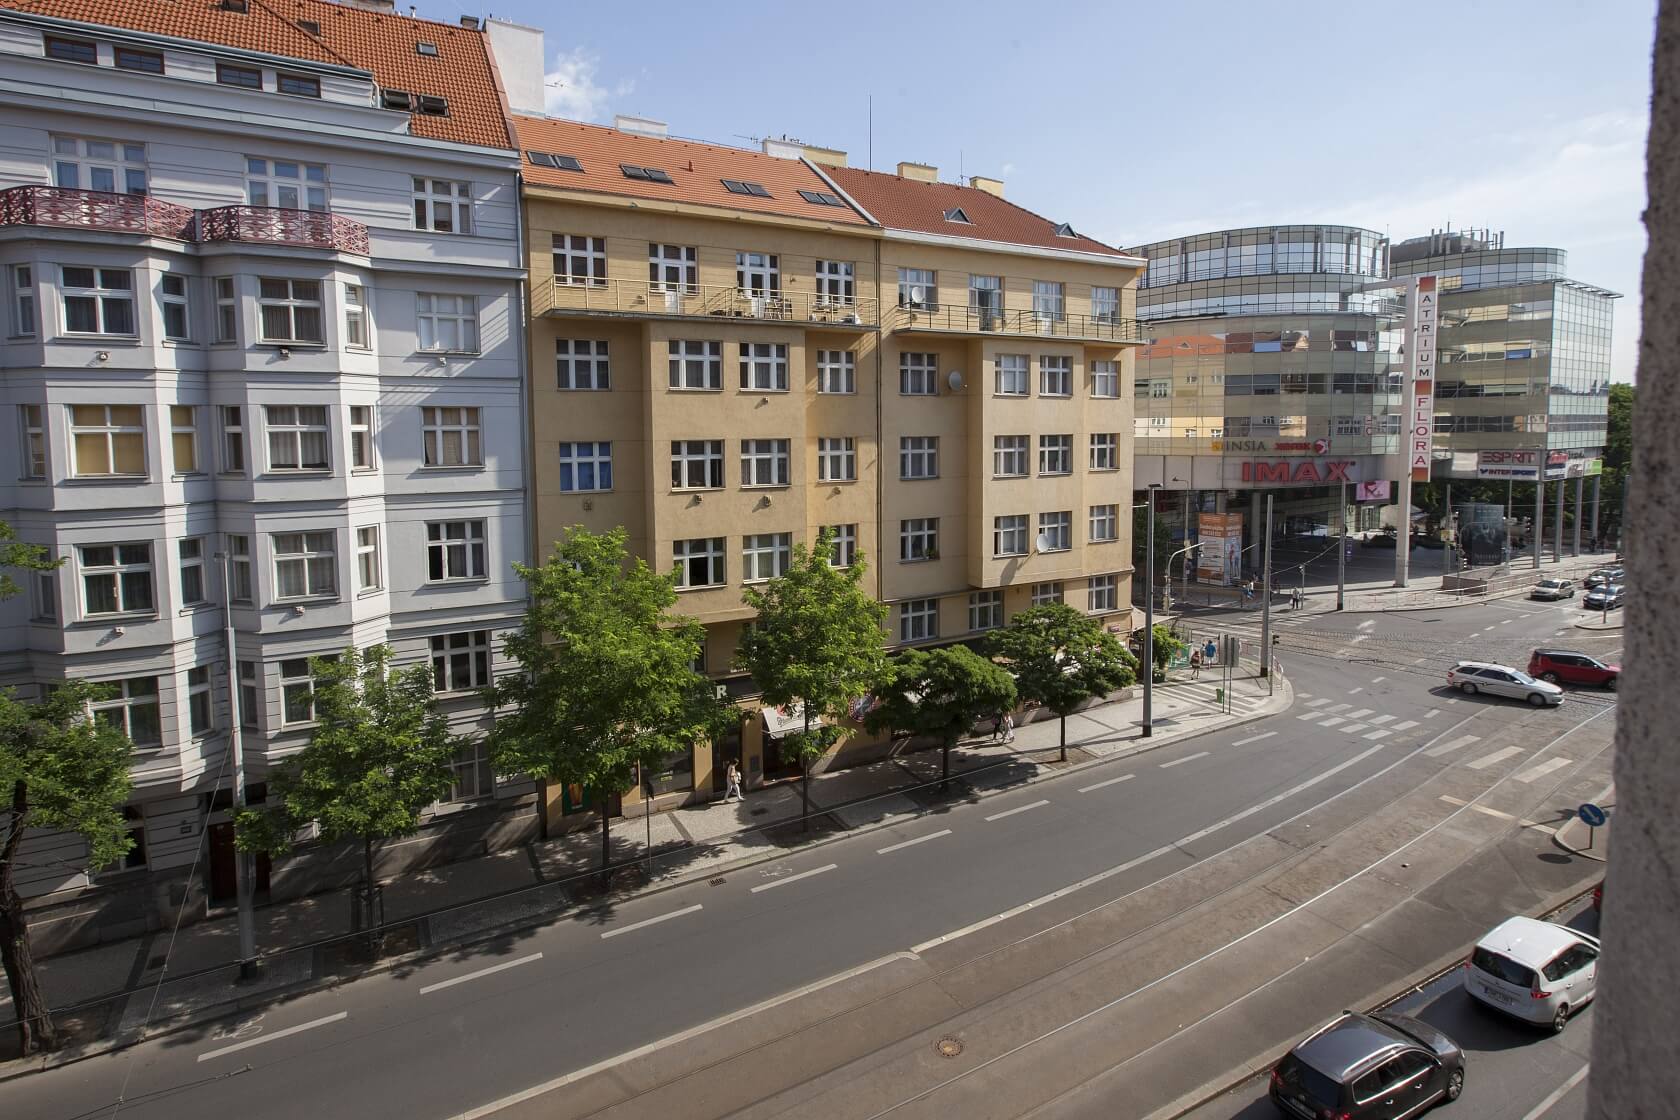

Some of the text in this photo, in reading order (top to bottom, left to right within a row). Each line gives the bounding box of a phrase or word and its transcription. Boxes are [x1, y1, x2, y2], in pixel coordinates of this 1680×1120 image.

[1415, 295, 1432, 465] ATRIUM FLORA
[1226, 440, 1267, 451] INSIA
[1481, 451, 1536, 464] ESPRIT
[1241, 461, 1351, 482] IMAX
